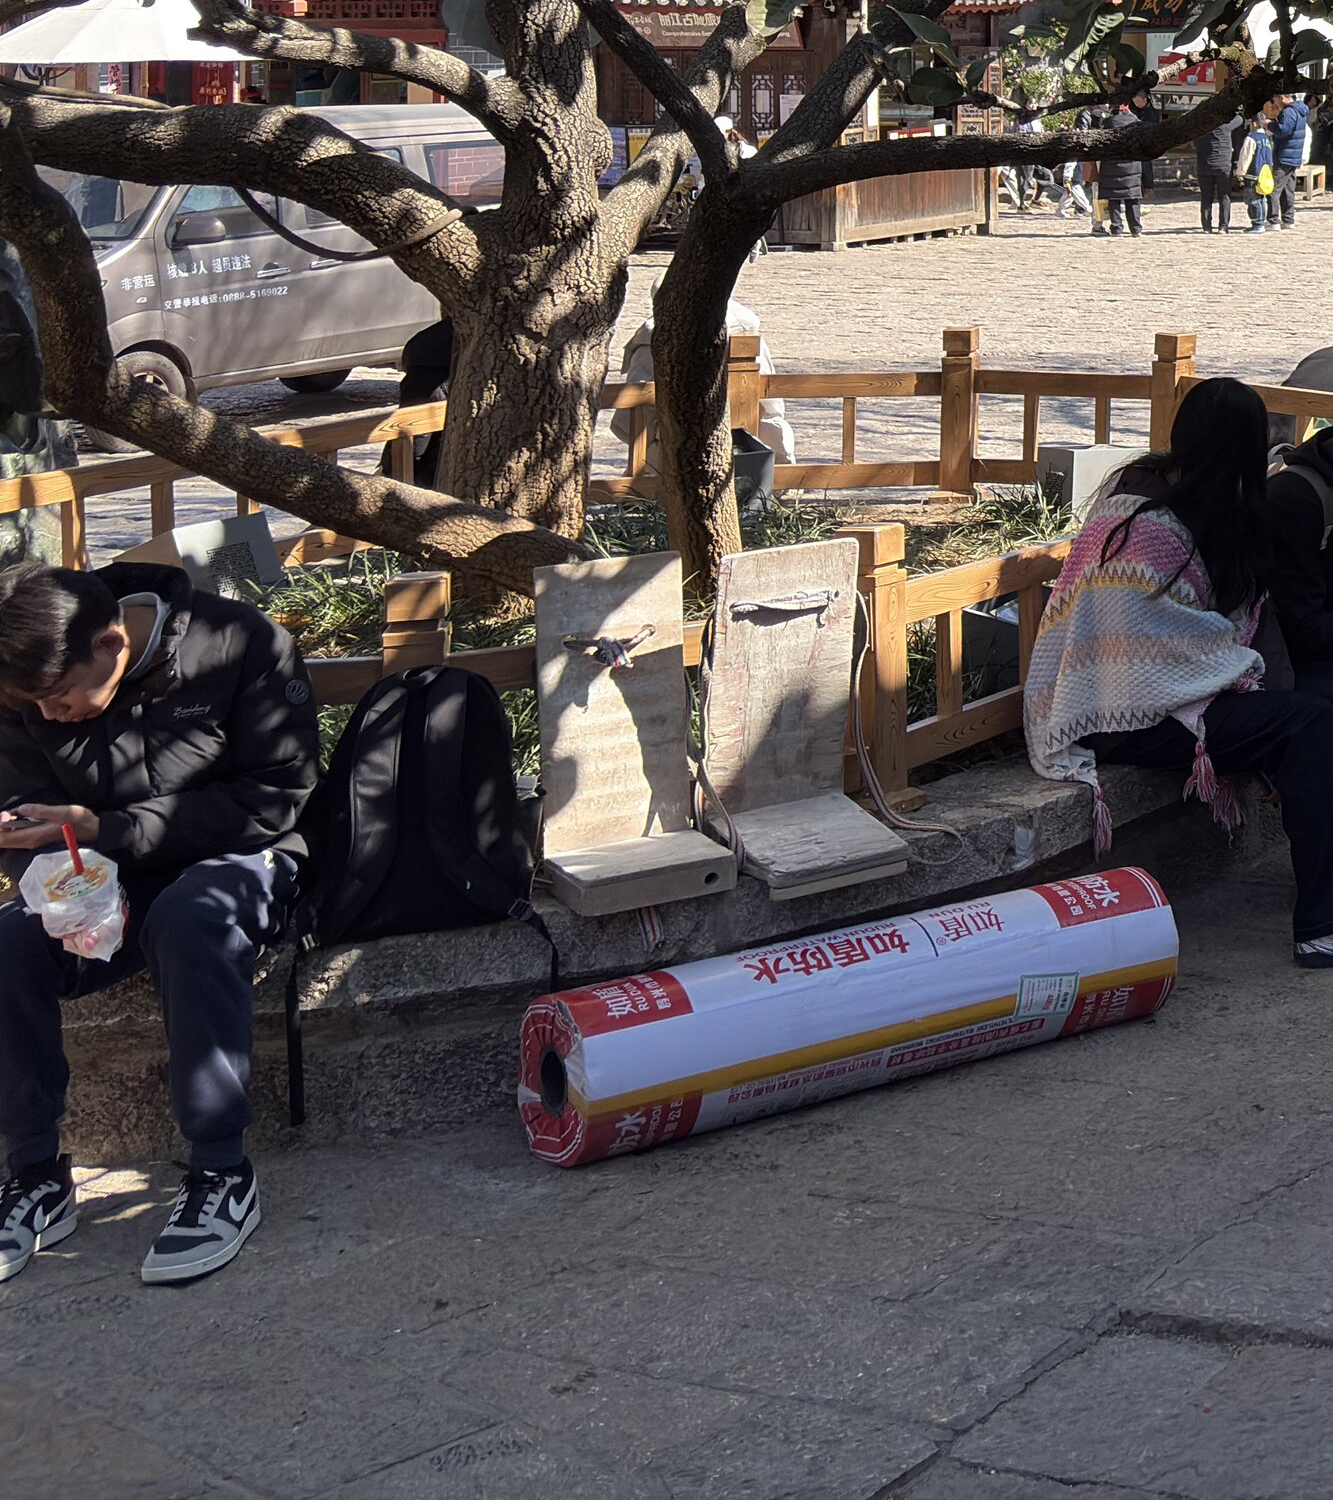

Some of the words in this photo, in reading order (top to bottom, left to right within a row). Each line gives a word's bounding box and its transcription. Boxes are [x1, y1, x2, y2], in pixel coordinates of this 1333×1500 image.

[658, 11, 721, 28] 丽江古城旅
[211, 253, 252, 274] 超员违法
[121, 274, 156, 291] 非营运
[927, 905, 965, 920] DUN
[967, 901, 991, 911] RU
[841, 922, 897, 938] RUDUN
[938, 907, 1005, 942] 如盾
[742, 928, 911, 985] 如盾防水
[634, 996, 650, 1012] RU
